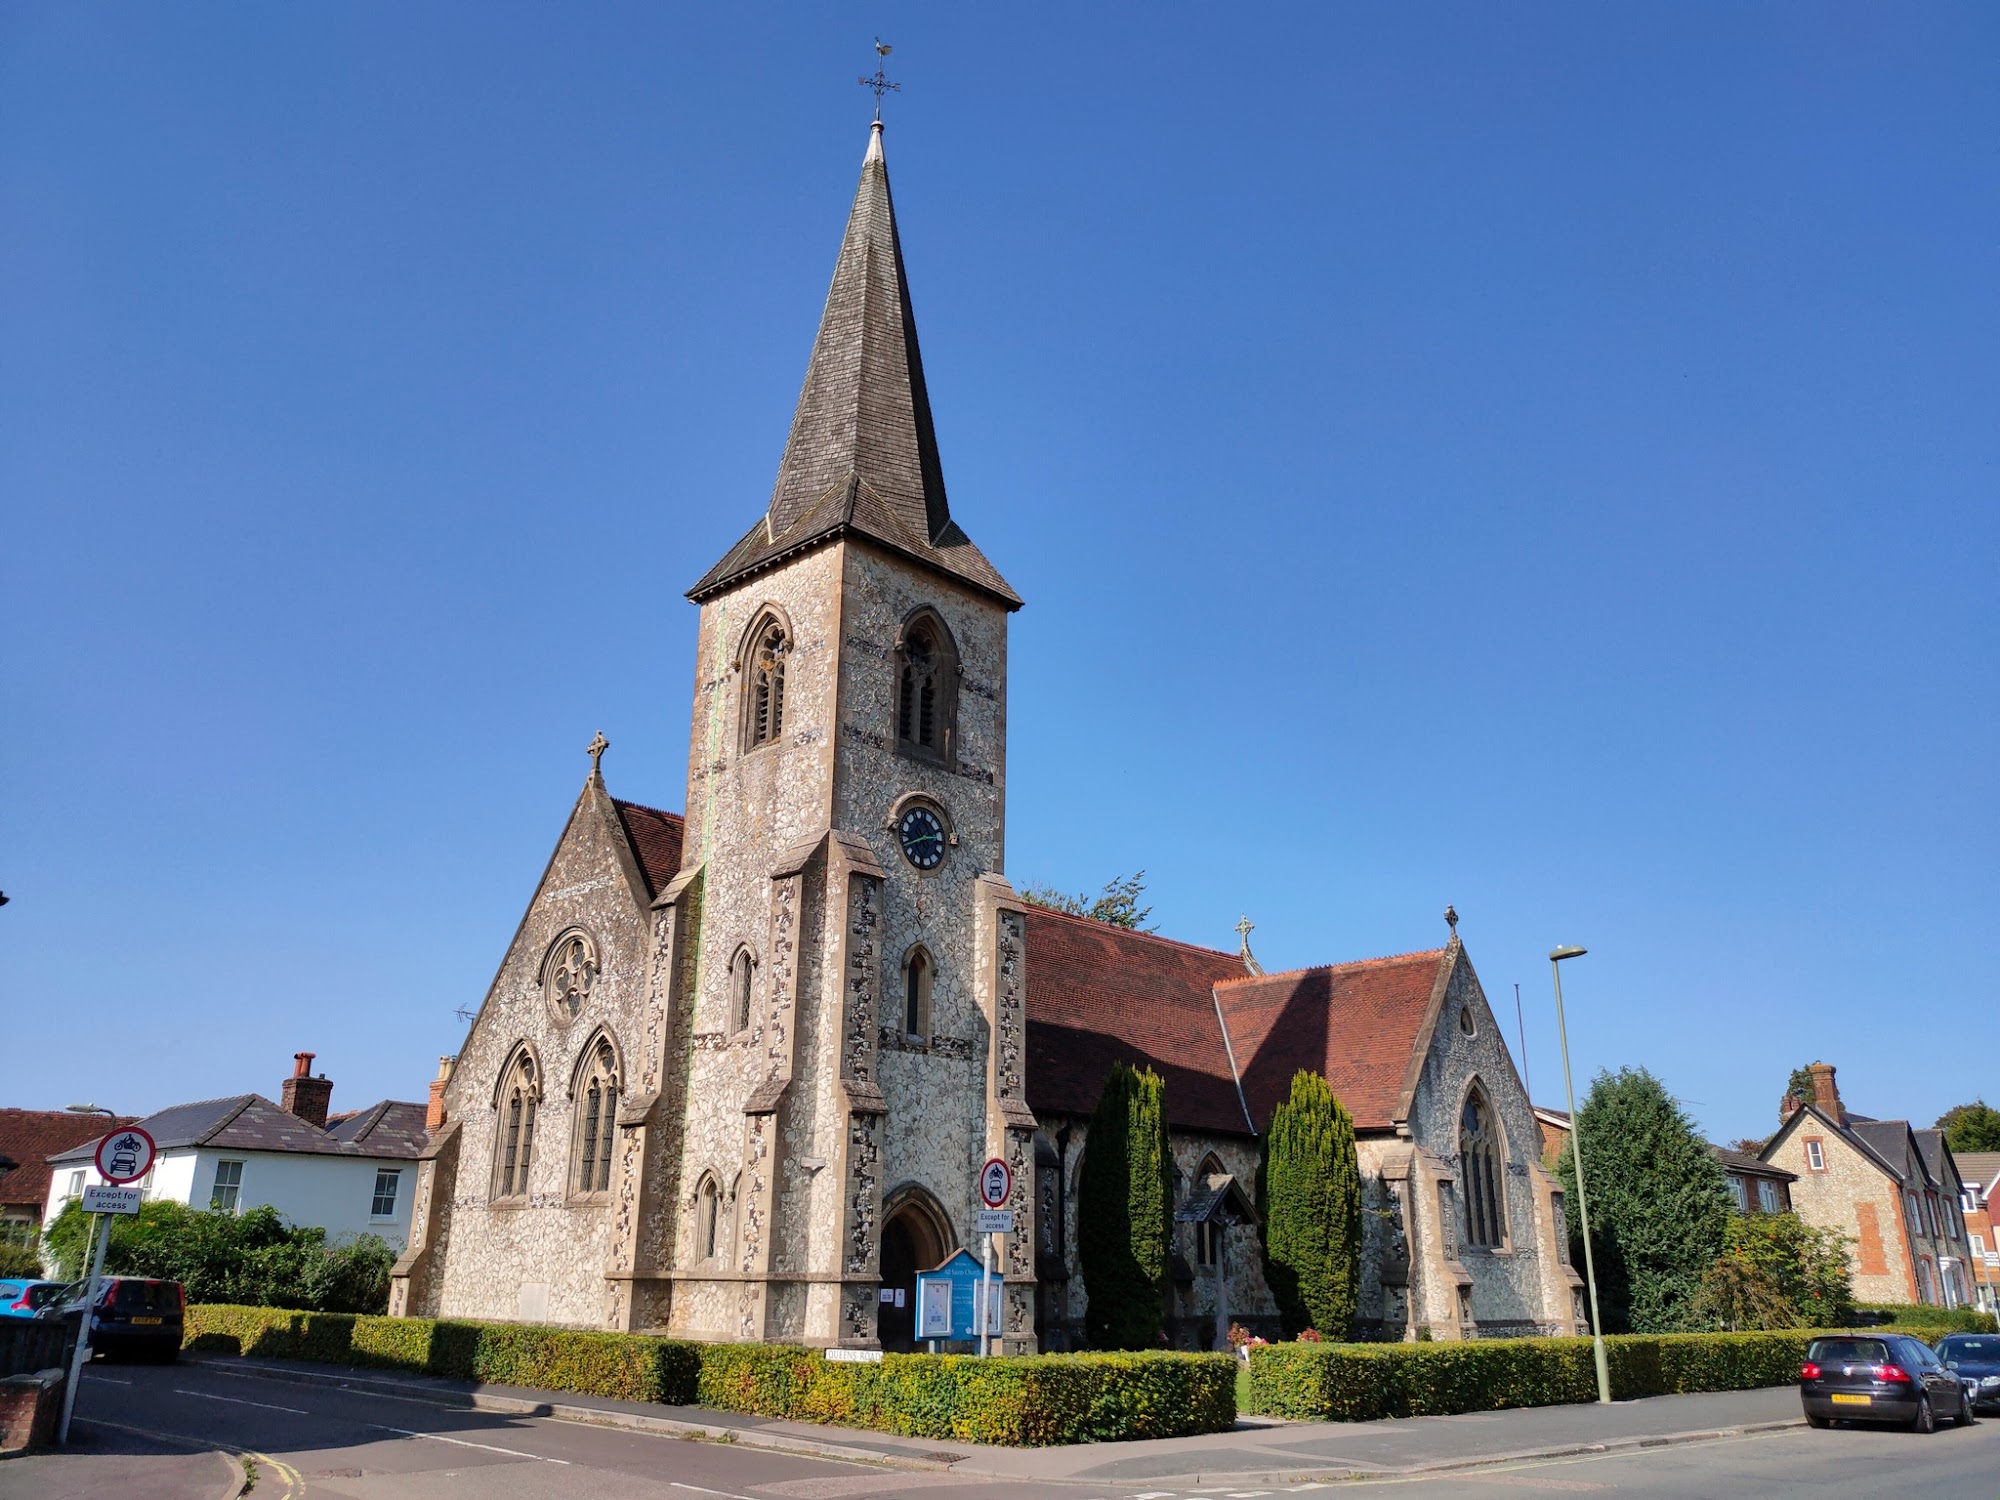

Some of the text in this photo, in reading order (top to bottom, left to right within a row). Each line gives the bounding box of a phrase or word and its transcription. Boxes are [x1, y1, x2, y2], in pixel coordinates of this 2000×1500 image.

[90, 1189, 137, 1200] Except for
[96, 1201, 127, 1210] access
[981, 1213, 1010, 1221] Except for
[828, 1350, 881, 1361] QUEENS ROAD
